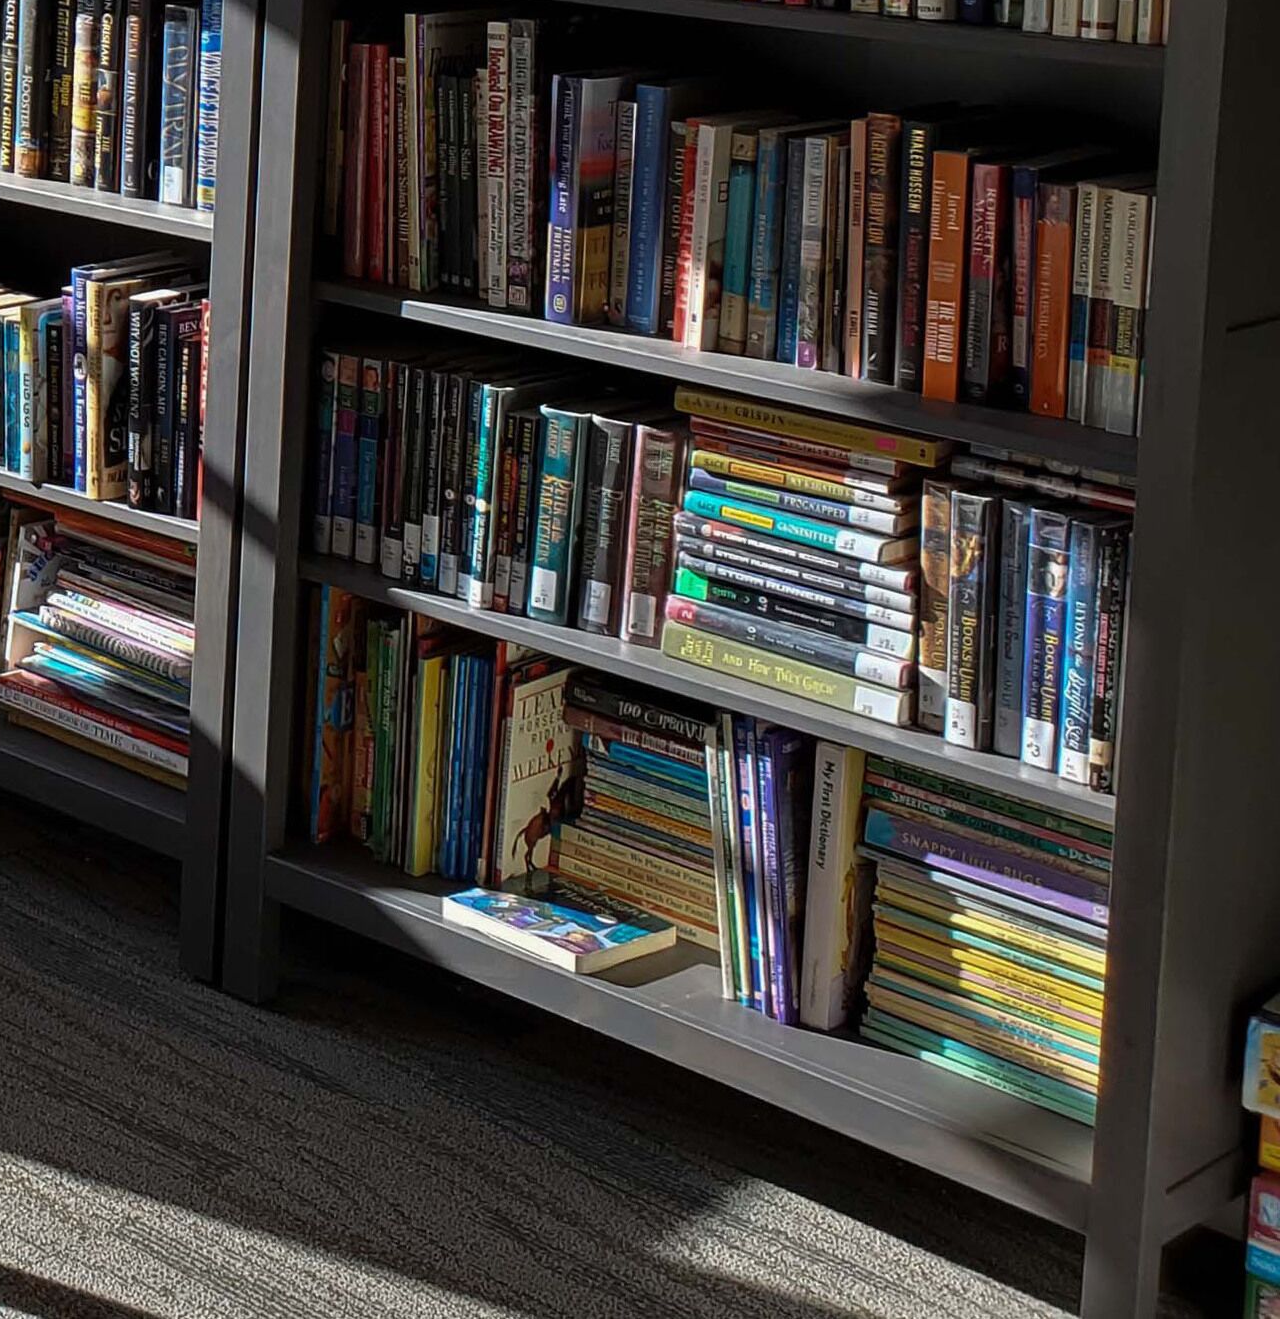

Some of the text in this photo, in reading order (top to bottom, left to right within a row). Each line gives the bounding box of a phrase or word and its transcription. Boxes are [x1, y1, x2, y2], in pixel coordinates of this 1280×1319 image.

[101, 13, 113, 65] GRISHAM
[3, 65, 14, 102] JOHN
[2, 106, 13, 165] GRISHAM
[488, 47, 505, 178] Hooked On DRAWING!
[616, 105, 632, 238] SPIRIT WARRIORS
[908, 129, 924, 213] KHALED HOSSEINI
[947, 192, 959, 230] Jared
[972, 199, 984, 256] MASSIE
[1079, 190, 1092, 278] MARLBOROUGH
[1098, 195, 1114, 283] MARLBOROUGH
[551, 226, 562, 282] FRIEDMAN
[1123, 202, 1138, 290] MARLBOROUGH
[662, 255, 673, 296] HARRIS
[868, 290, 878, 335] JEREMIAH
[937, 300, 956, 362] THE WORLD
[129, 311, 140, 418] WHY NOT WOMEN?
[734, 404, 785, 426] CRISPIN
[722, 653, 837, 696] AND How They Grew
[1044, 633, 1059, 680] BOOKS
[617, 701, 640, 719] 100
[817, 760, 835, 868] My First Dictionary
